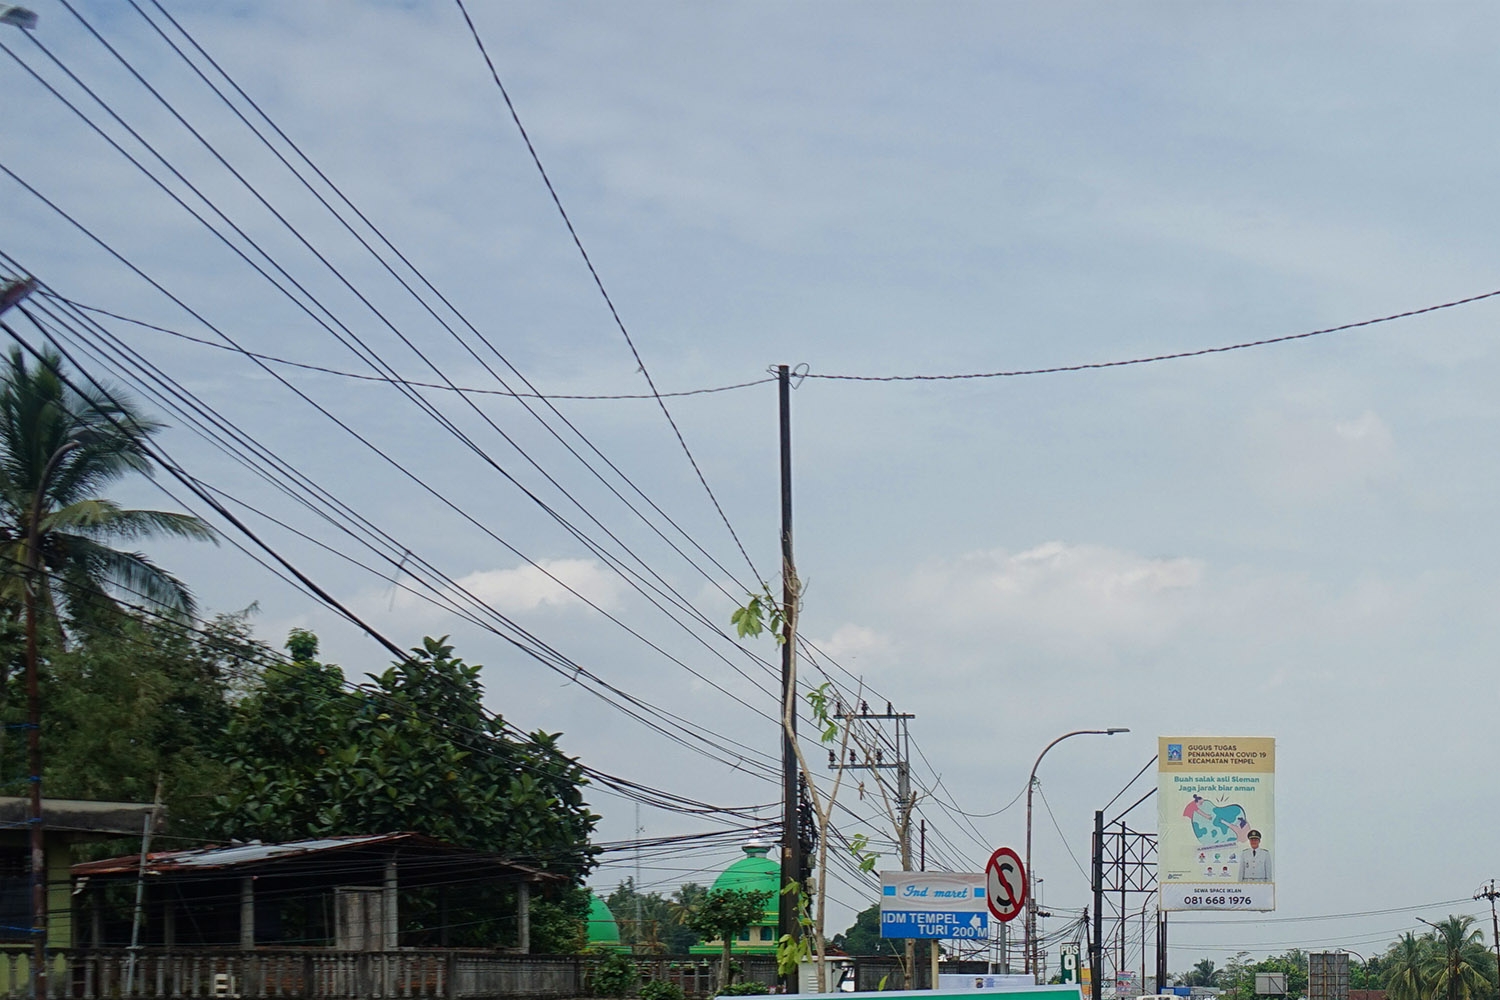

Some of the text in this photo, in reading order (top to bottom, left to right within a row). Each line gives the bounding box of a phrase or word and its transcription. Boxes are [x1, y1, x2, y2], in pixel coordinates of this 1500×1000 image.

[1184, 896, 1252, 905] 081 668 1976
[882, 912, 960, 925] IDM TEMPEL
[917, 924, 988, 937] TURI 200 M
